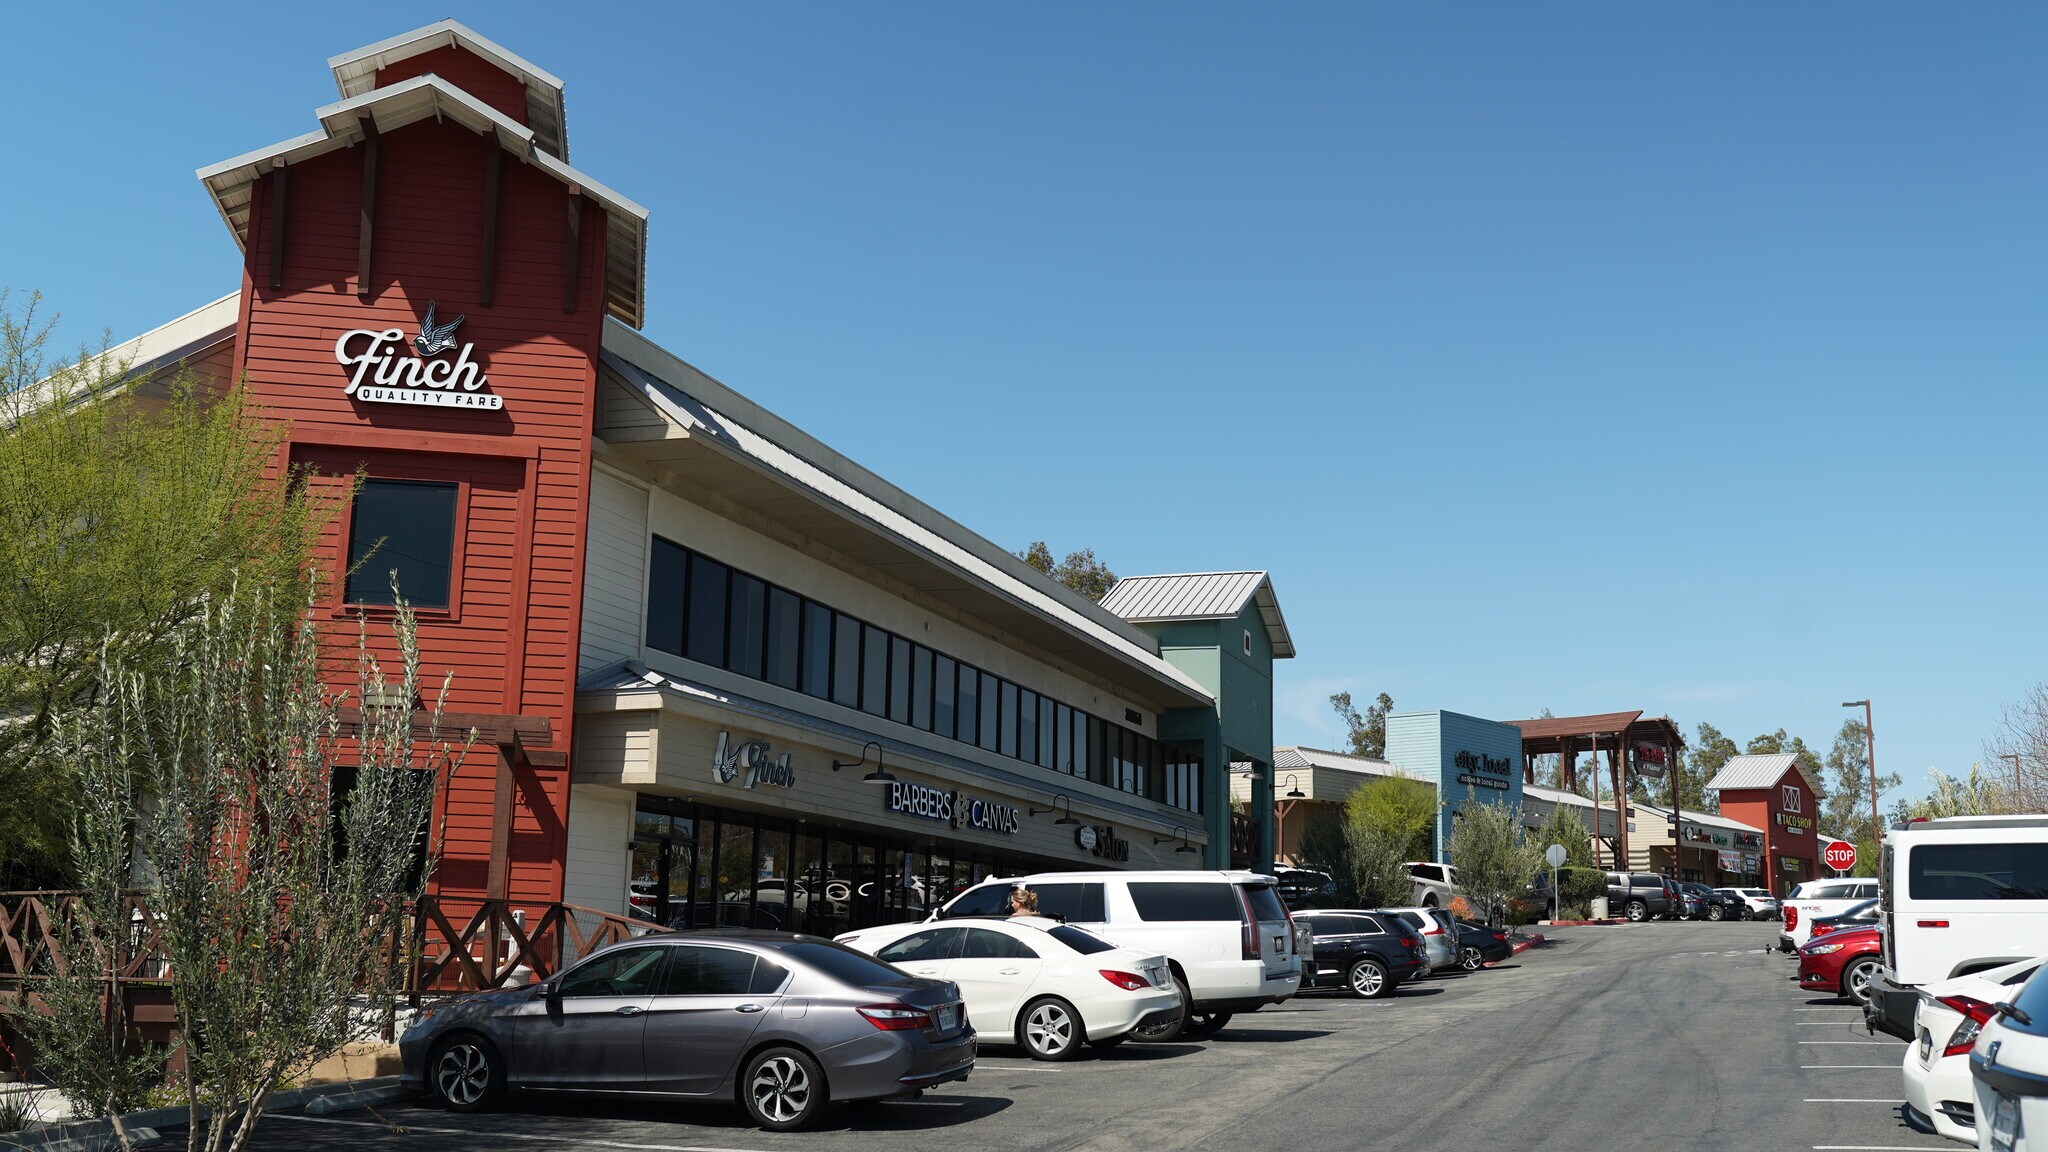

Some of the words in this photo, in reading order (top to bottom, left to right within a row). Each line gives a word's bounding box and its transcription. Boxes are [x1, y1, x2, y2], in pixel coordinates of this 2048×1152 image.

[335, 328, 487, 395] Finch
[362, 388, 442, 403] QUALITY
[455, 395, 497, 407] FARE
[741, 742, 795, 789] Finch
[1461, 775, 1476, 784] coffee
[1481, 778, 1493, 786] local
[1493, 781, 1508, 789] goods
[892, 782, 951, 820] BARBERS
[972, 800, 1019, 834] CANVAS
[1782, 814, 1797, 827] TACO
[1797, 816, 1812, 829] SHOP
[1827, 850, 1854, 861] STOP
